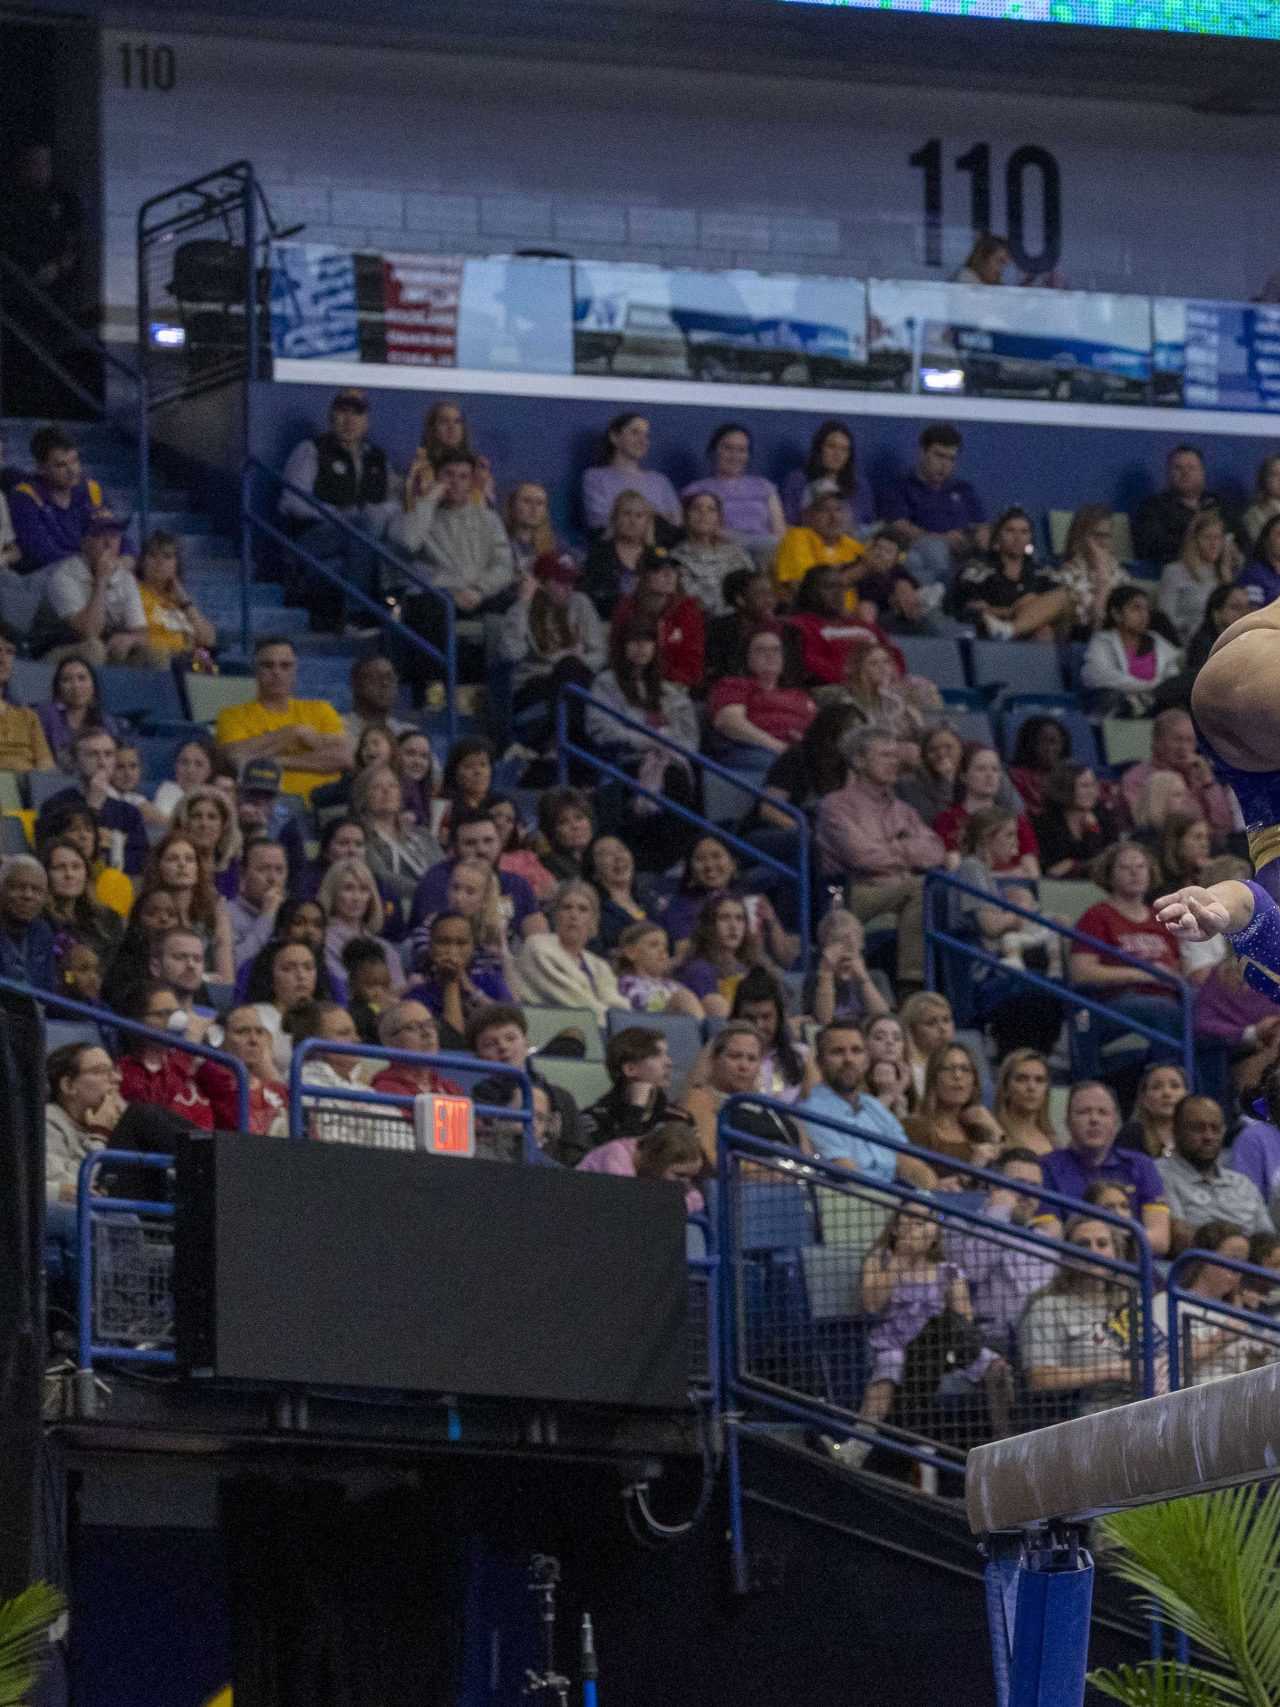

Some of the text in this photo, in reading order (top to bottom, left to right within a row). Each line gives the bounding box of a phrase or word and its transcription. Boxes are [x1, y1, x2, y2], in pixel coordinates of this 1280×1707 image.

[118, 43, 175, 91] 110
[909, 138, 1061, 274] 110
[433, 1099, 468, 1152] EXIT
